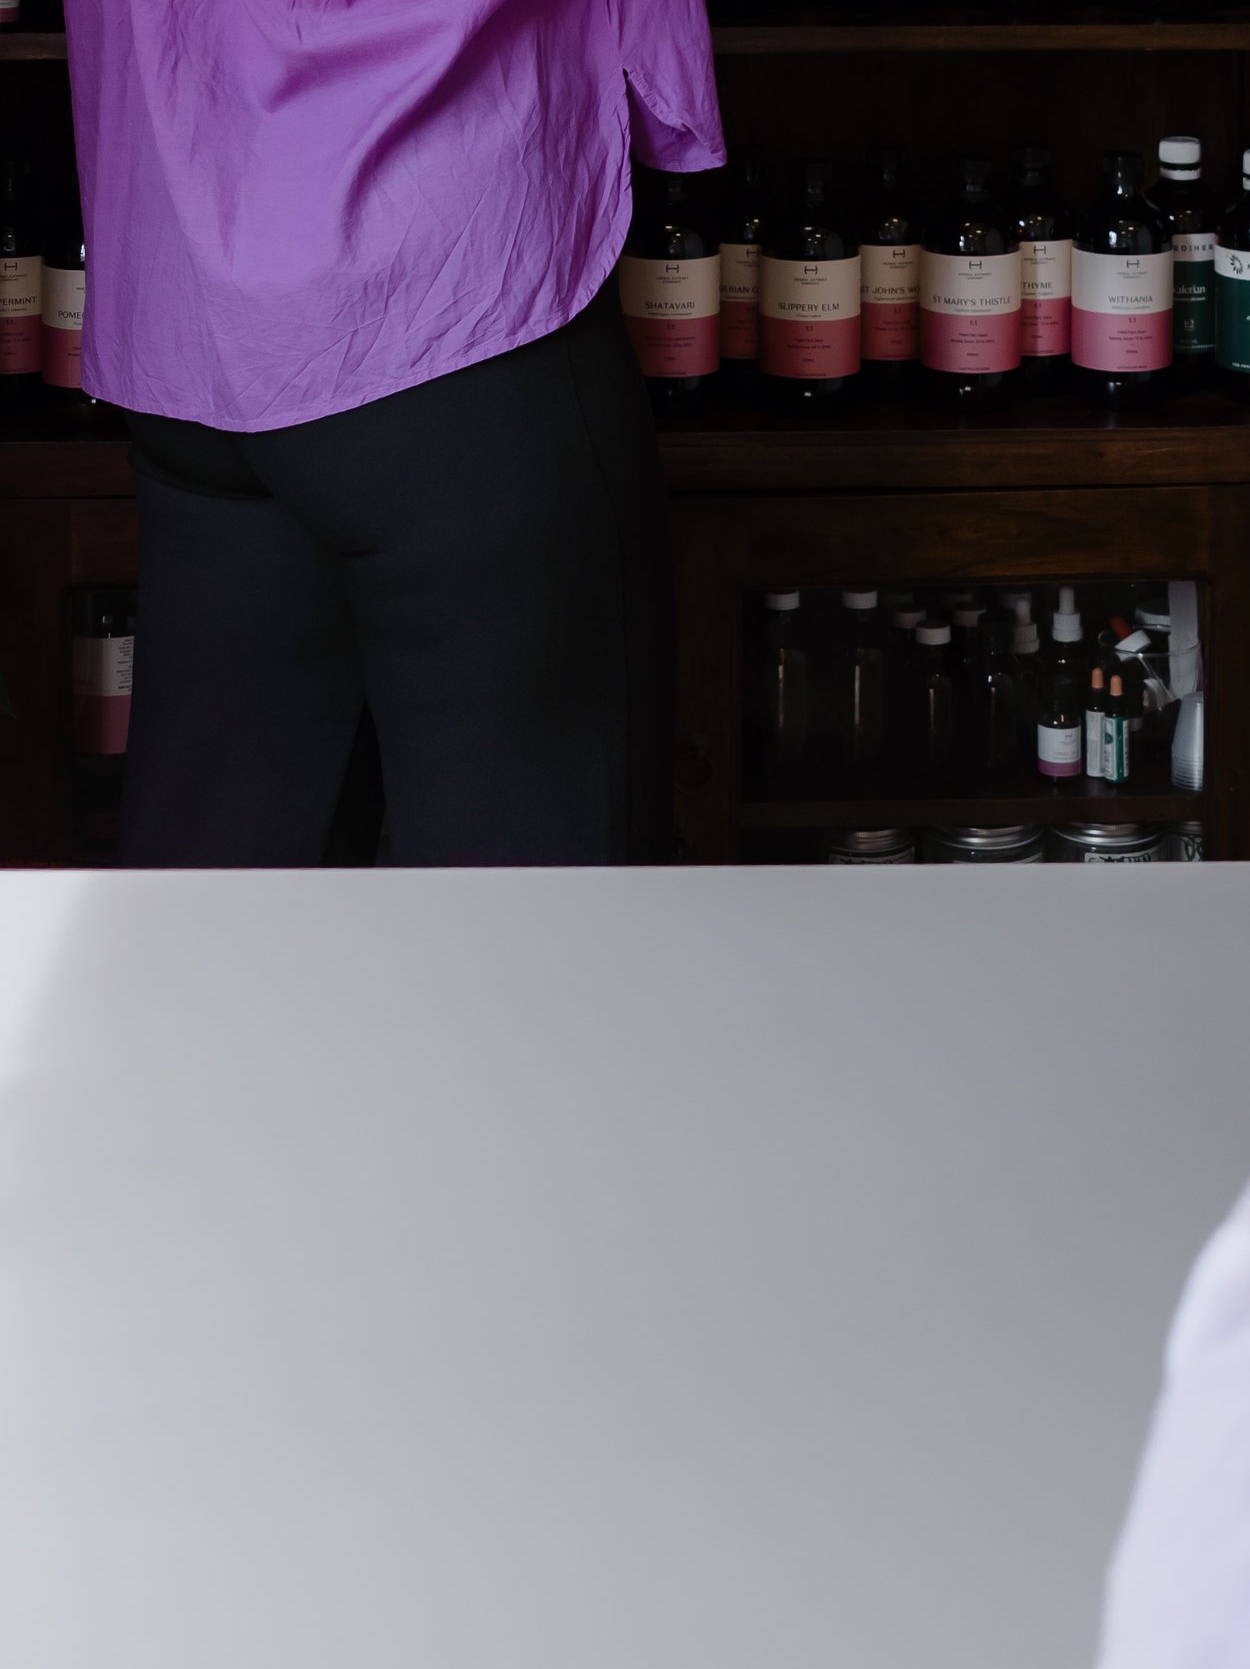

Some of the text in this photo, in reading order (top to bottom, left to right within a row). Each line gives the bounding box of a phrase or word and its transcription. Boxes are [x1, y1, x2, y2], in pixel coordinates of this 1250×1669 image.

[872, 286, 906, 295] JOHN'S
[1022, 282, 1052, 290] THYME
[933, 296, 1010, 306] ST MARY'S THISTLE
[1108, 295, 1154, 304] WITHANIA
[645, 301, 695, 310] SHATAVARI
[778, 302, 840, 312] SLIPPERY ELM
[58, 310, 82, 319] POME
